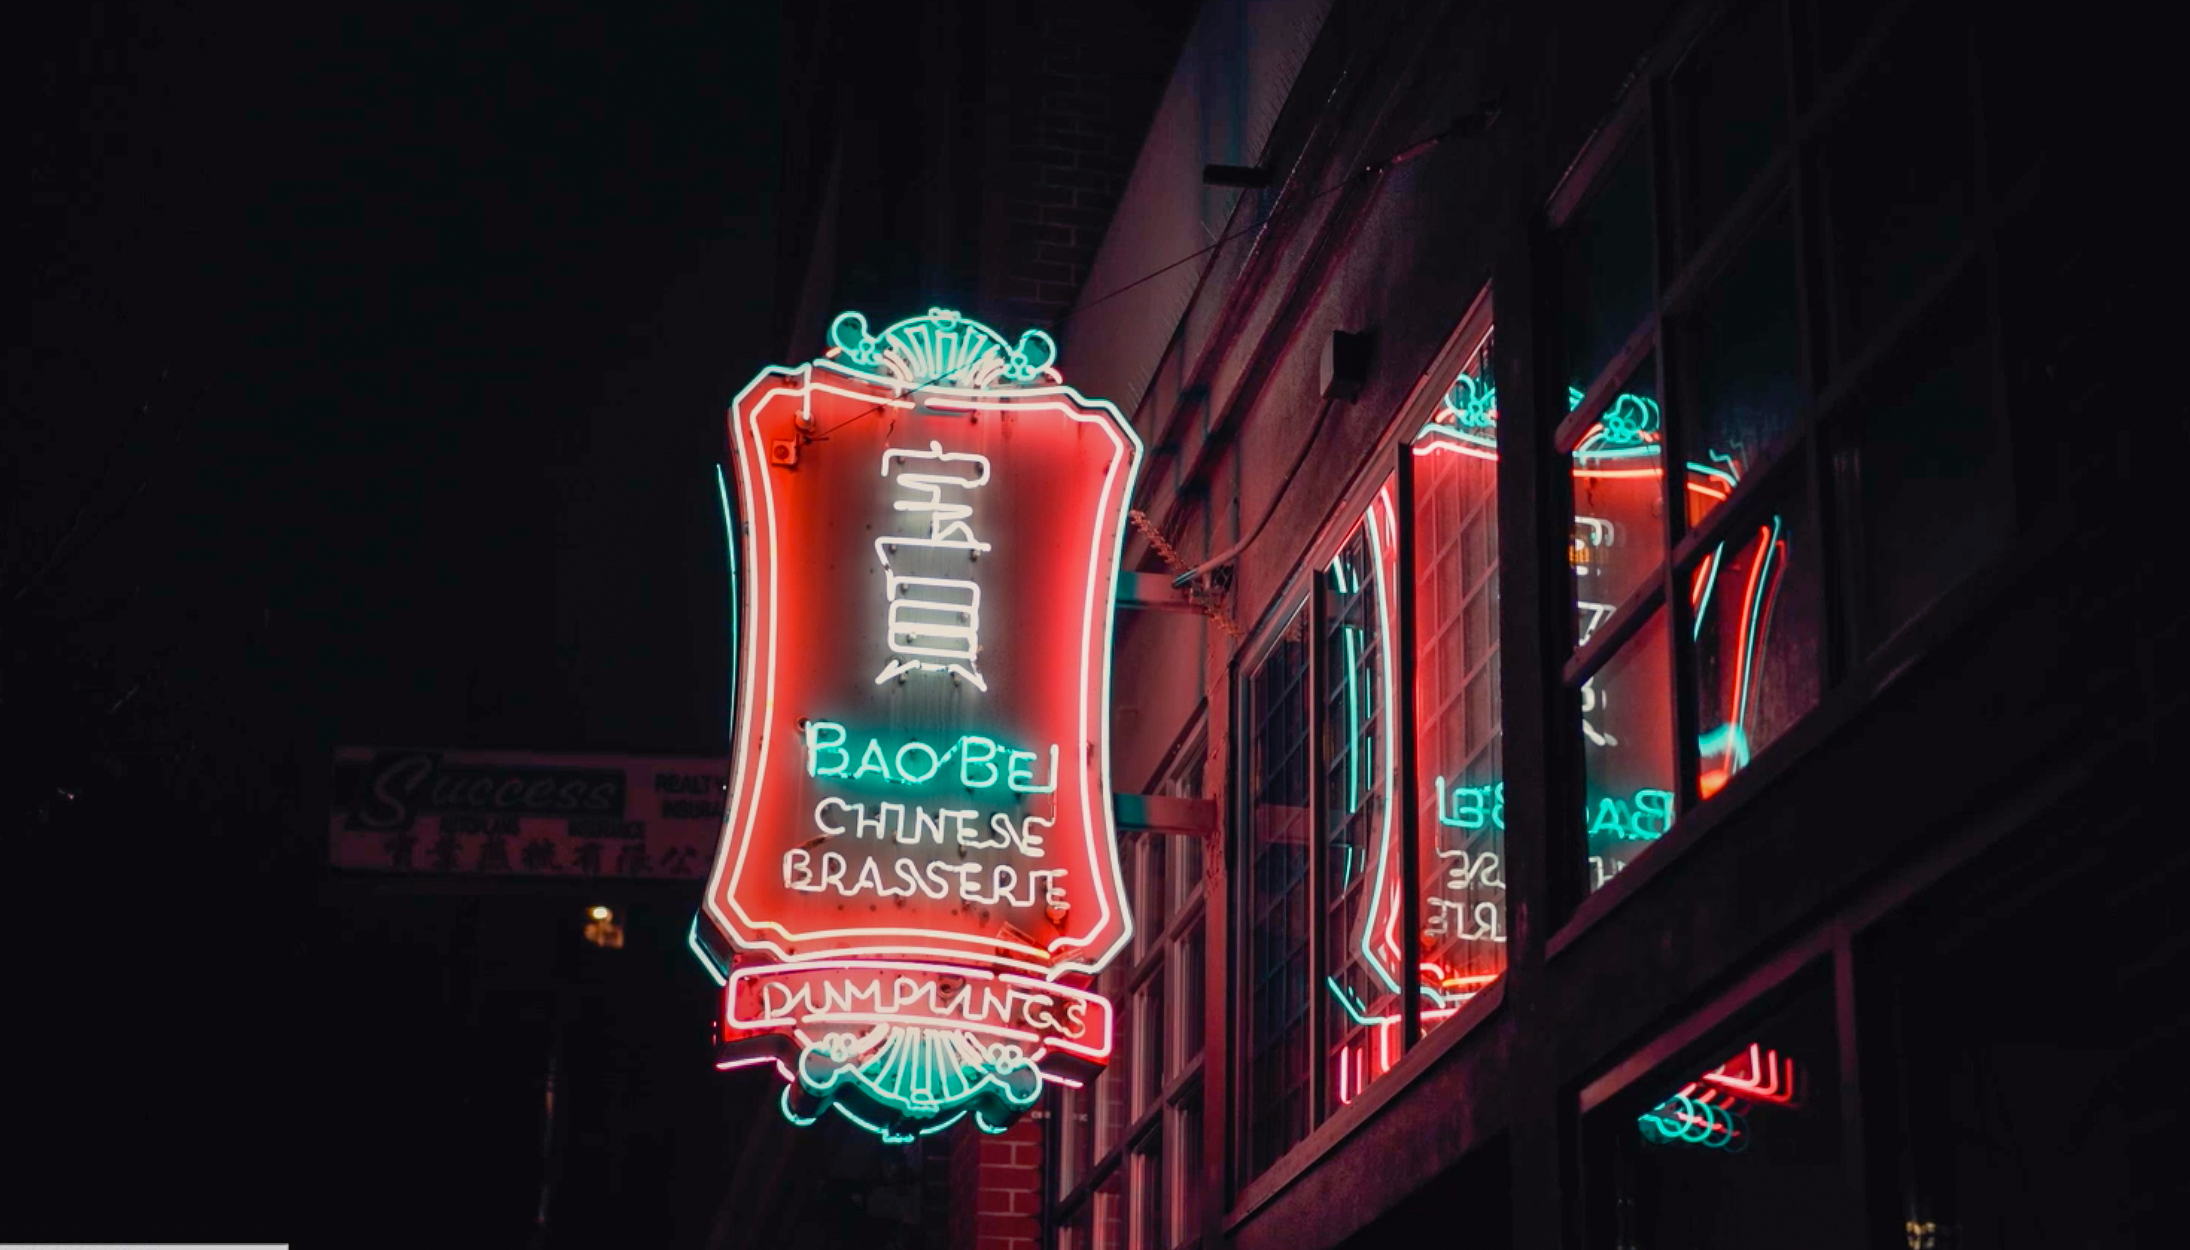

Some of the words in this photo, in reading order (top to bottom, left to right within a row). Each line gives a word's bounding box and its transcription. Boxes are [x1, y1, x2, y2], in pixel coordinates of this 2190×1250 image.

[804, 720, 939, 784] BAO
[959, 736, 1059, 793] BEI
[360, 755, 618, 827] Success
[814, 797, 1054, 857] CHINESE
[783, 849, 1071, 909] BRASSERIE
[763, 976, 1087, 1039] DUMPLINGS
